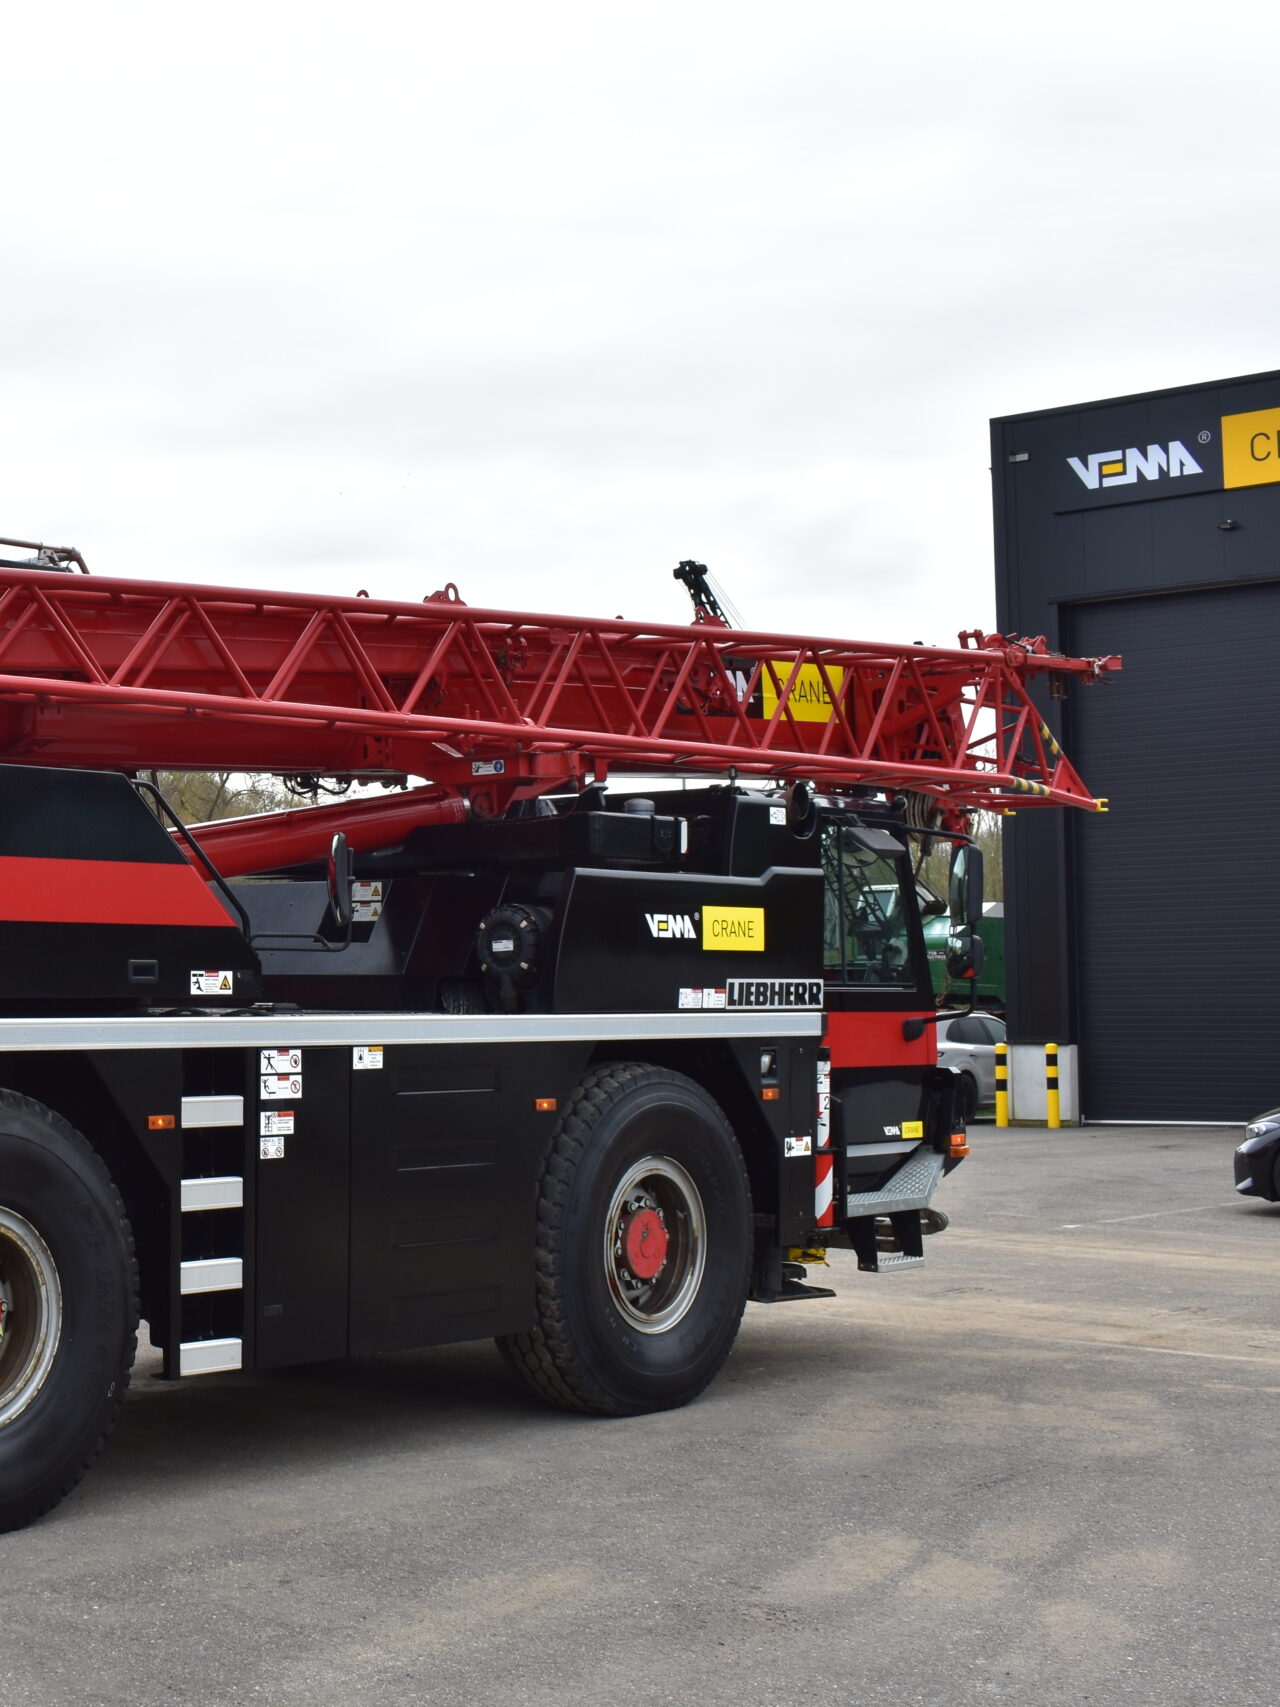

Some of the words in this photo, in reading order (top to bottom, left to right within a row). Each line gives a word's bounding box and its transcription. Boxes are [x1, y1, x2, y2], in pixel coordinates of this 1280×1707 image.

[1066, 440, 1204, 490] VEMA
[644, 913, 697, 939] VEMA
[712, 919, 755, 938] CRANE
[727, 982, 822, 1006] LIEBHERR
[823, 1096, 830, 1110] 2
[904, 1124, 920, 1135] CRANE
